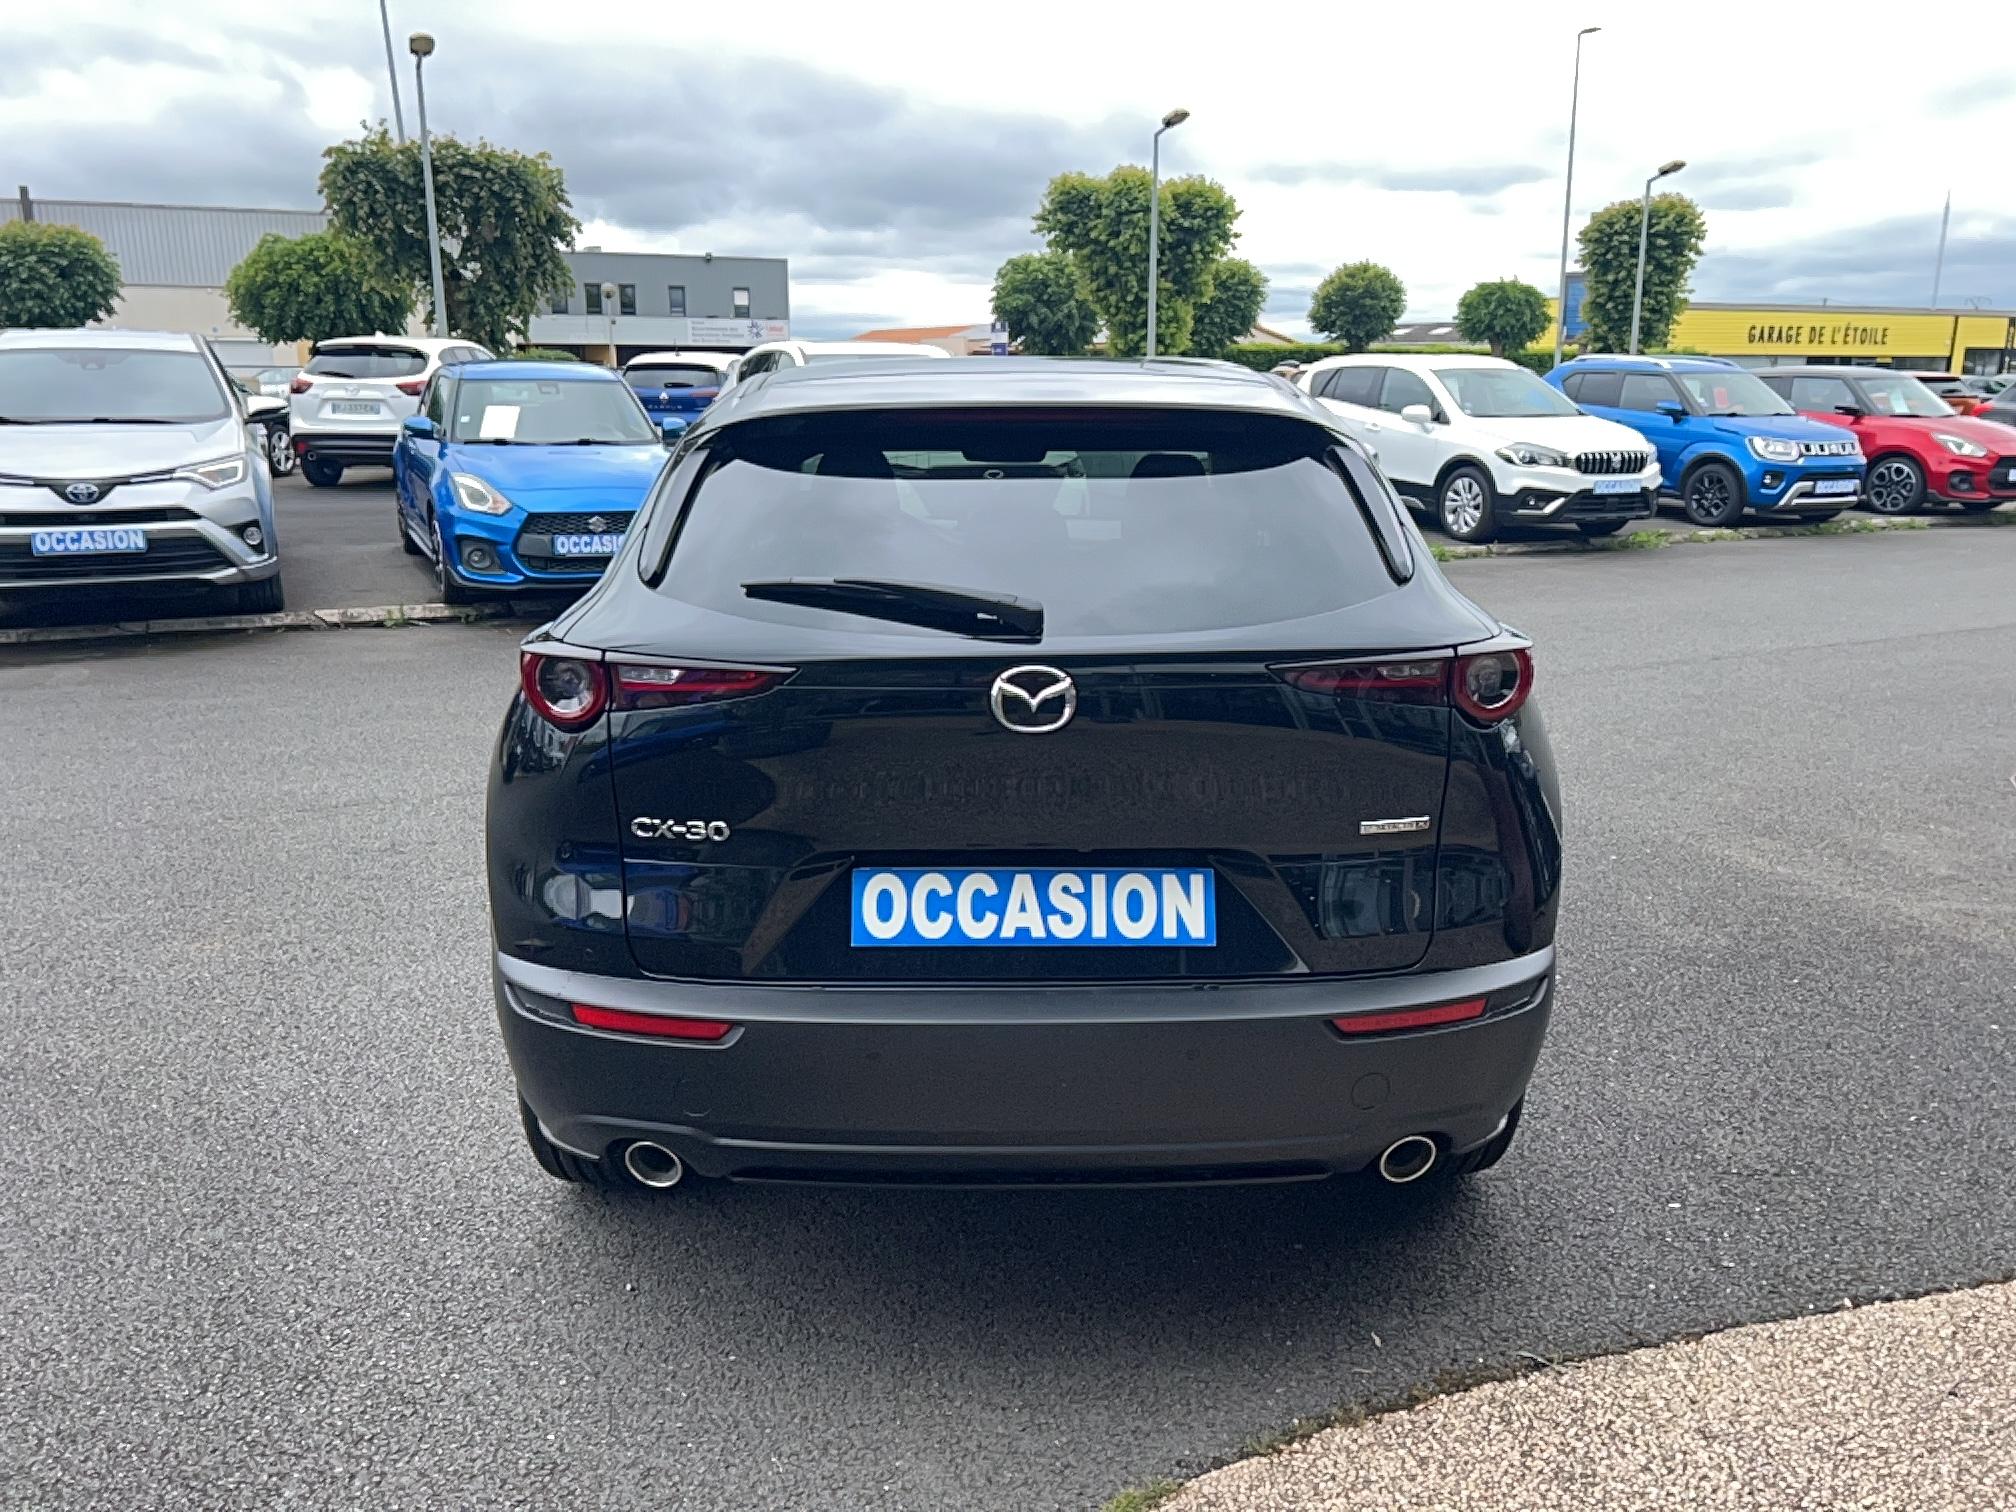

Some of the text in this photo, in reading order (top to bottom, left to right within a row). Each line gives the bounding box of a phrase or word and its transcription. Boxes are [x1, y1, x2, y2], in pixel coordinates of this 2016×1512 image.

[1748, 323, 1889, 345] GARAGE DE L'ÉTOILE
[35, 530, 144, 552] OCCASION
[630, 816, 731, 842] CX-30
[862, 872, 1206, 940] OCCASION
